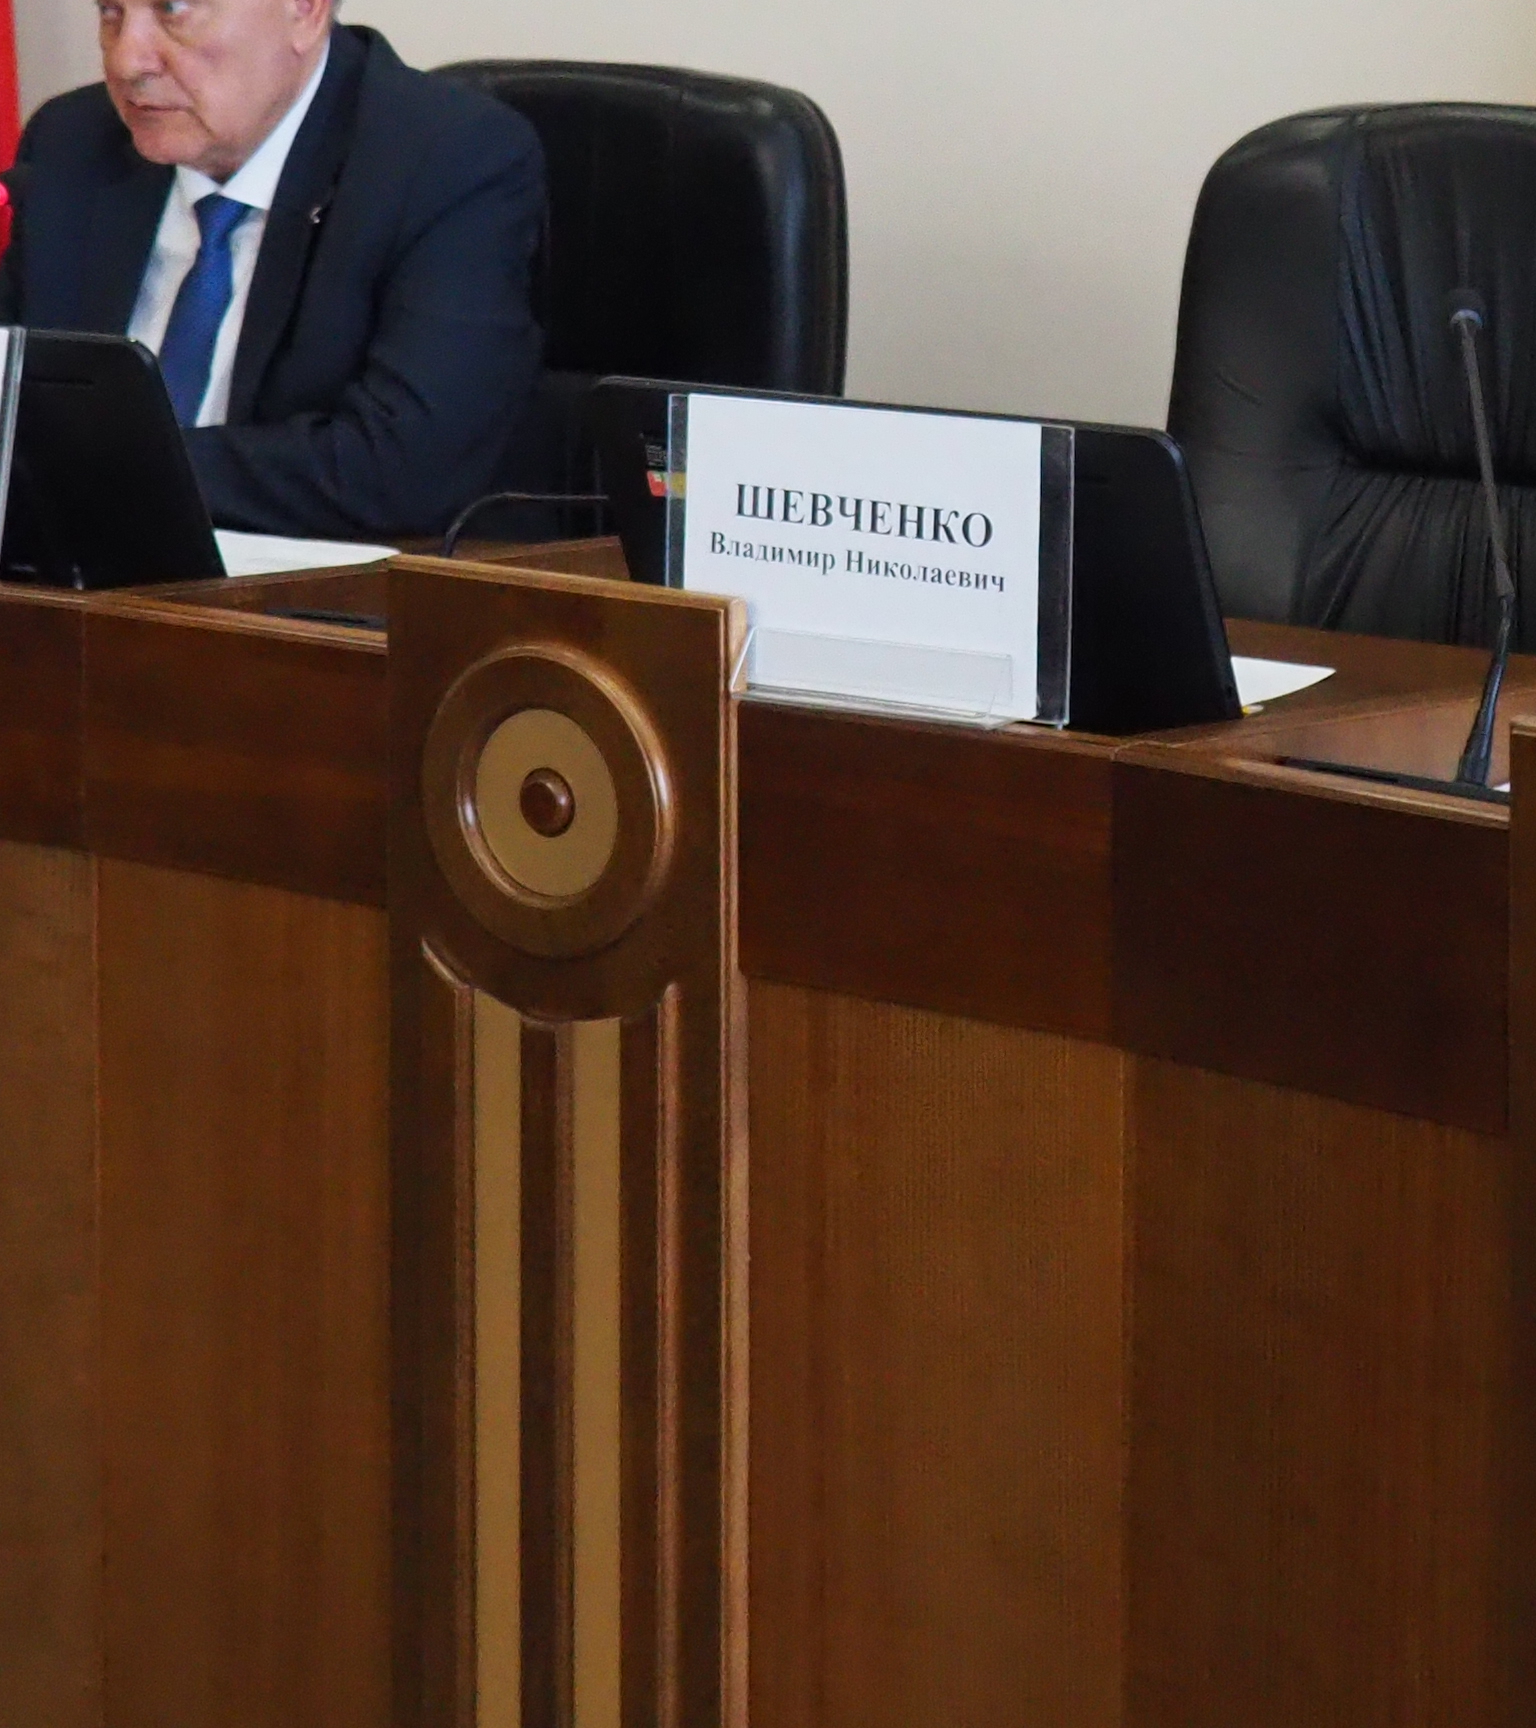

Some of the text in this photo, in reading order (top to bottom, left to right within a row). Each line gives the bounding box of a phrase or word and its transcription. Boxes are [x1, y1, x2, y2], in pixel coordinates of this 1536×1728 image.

[735, 483, 994, 549] ШЕВЧЕНКО
[710, 530, 1006, 594] Владимир Николаевич
